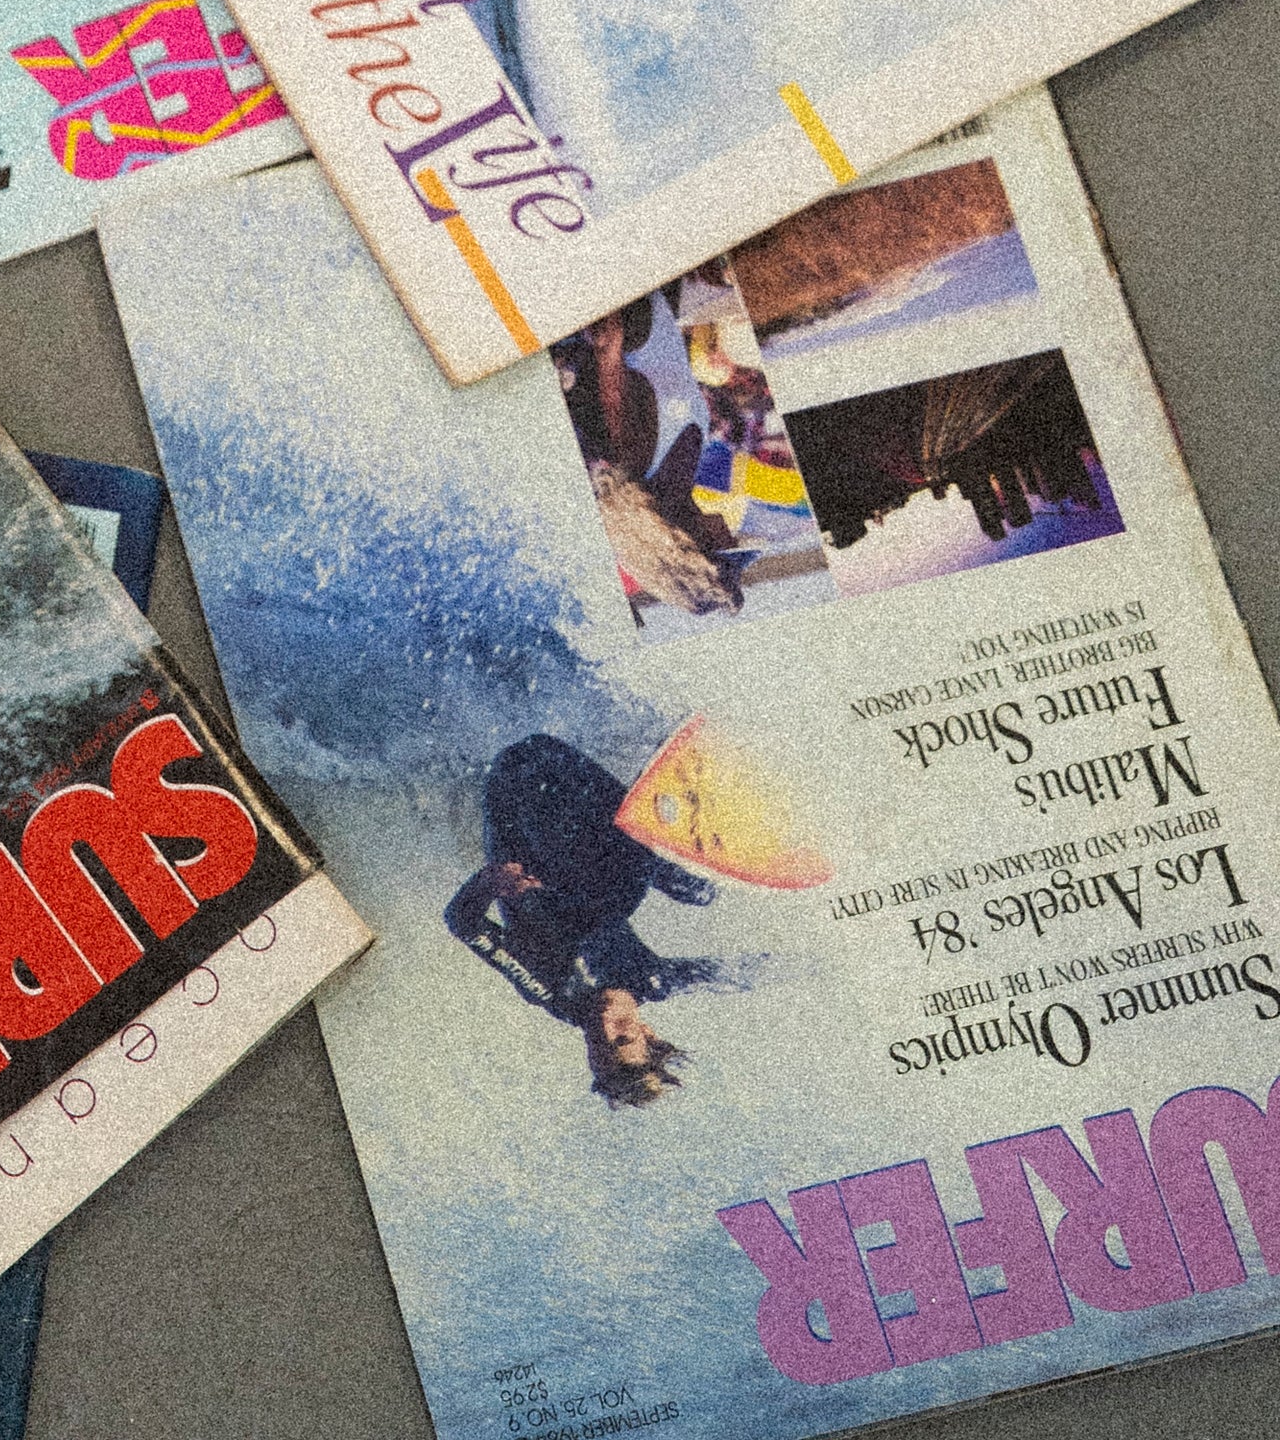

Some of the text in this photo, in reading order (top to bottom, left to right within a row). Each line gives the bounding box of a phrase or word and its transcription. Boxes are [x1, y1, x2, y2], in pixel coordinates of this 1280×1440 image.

[383, 80, 597, 242] Life
[1012, 608, 1122, 645] WATCHING
[1123, 599, 1146, 621] IS
[1118, 629, 1158, 657] BIG
[849, 685, 932, 720] CARSON
[934, 667, 1003, 700] LANCE
[893, 665, 1182, 769] Future Shock
[1013, 735, 1206, 814] Malibu's
[828, 806, 1221, 921] RIPPING AND BREAKING IN SURF CITY!
[1153, 842, 1247, 908] Los
[982, 864, 1143, 937] Angeles
[1110, 929, 1206, 968] SURFERS
[1210, 918, 1262, 946] WHY
[919, 979, 996, 1017] THERE!
[1000, 970, 1033, 997] BE
[888, 953, 1280, 1076] Summer Olympics
[718, 1074, 1280, 1385] URFER
[582, 1399, 680, 1440] SEPTEMBER
